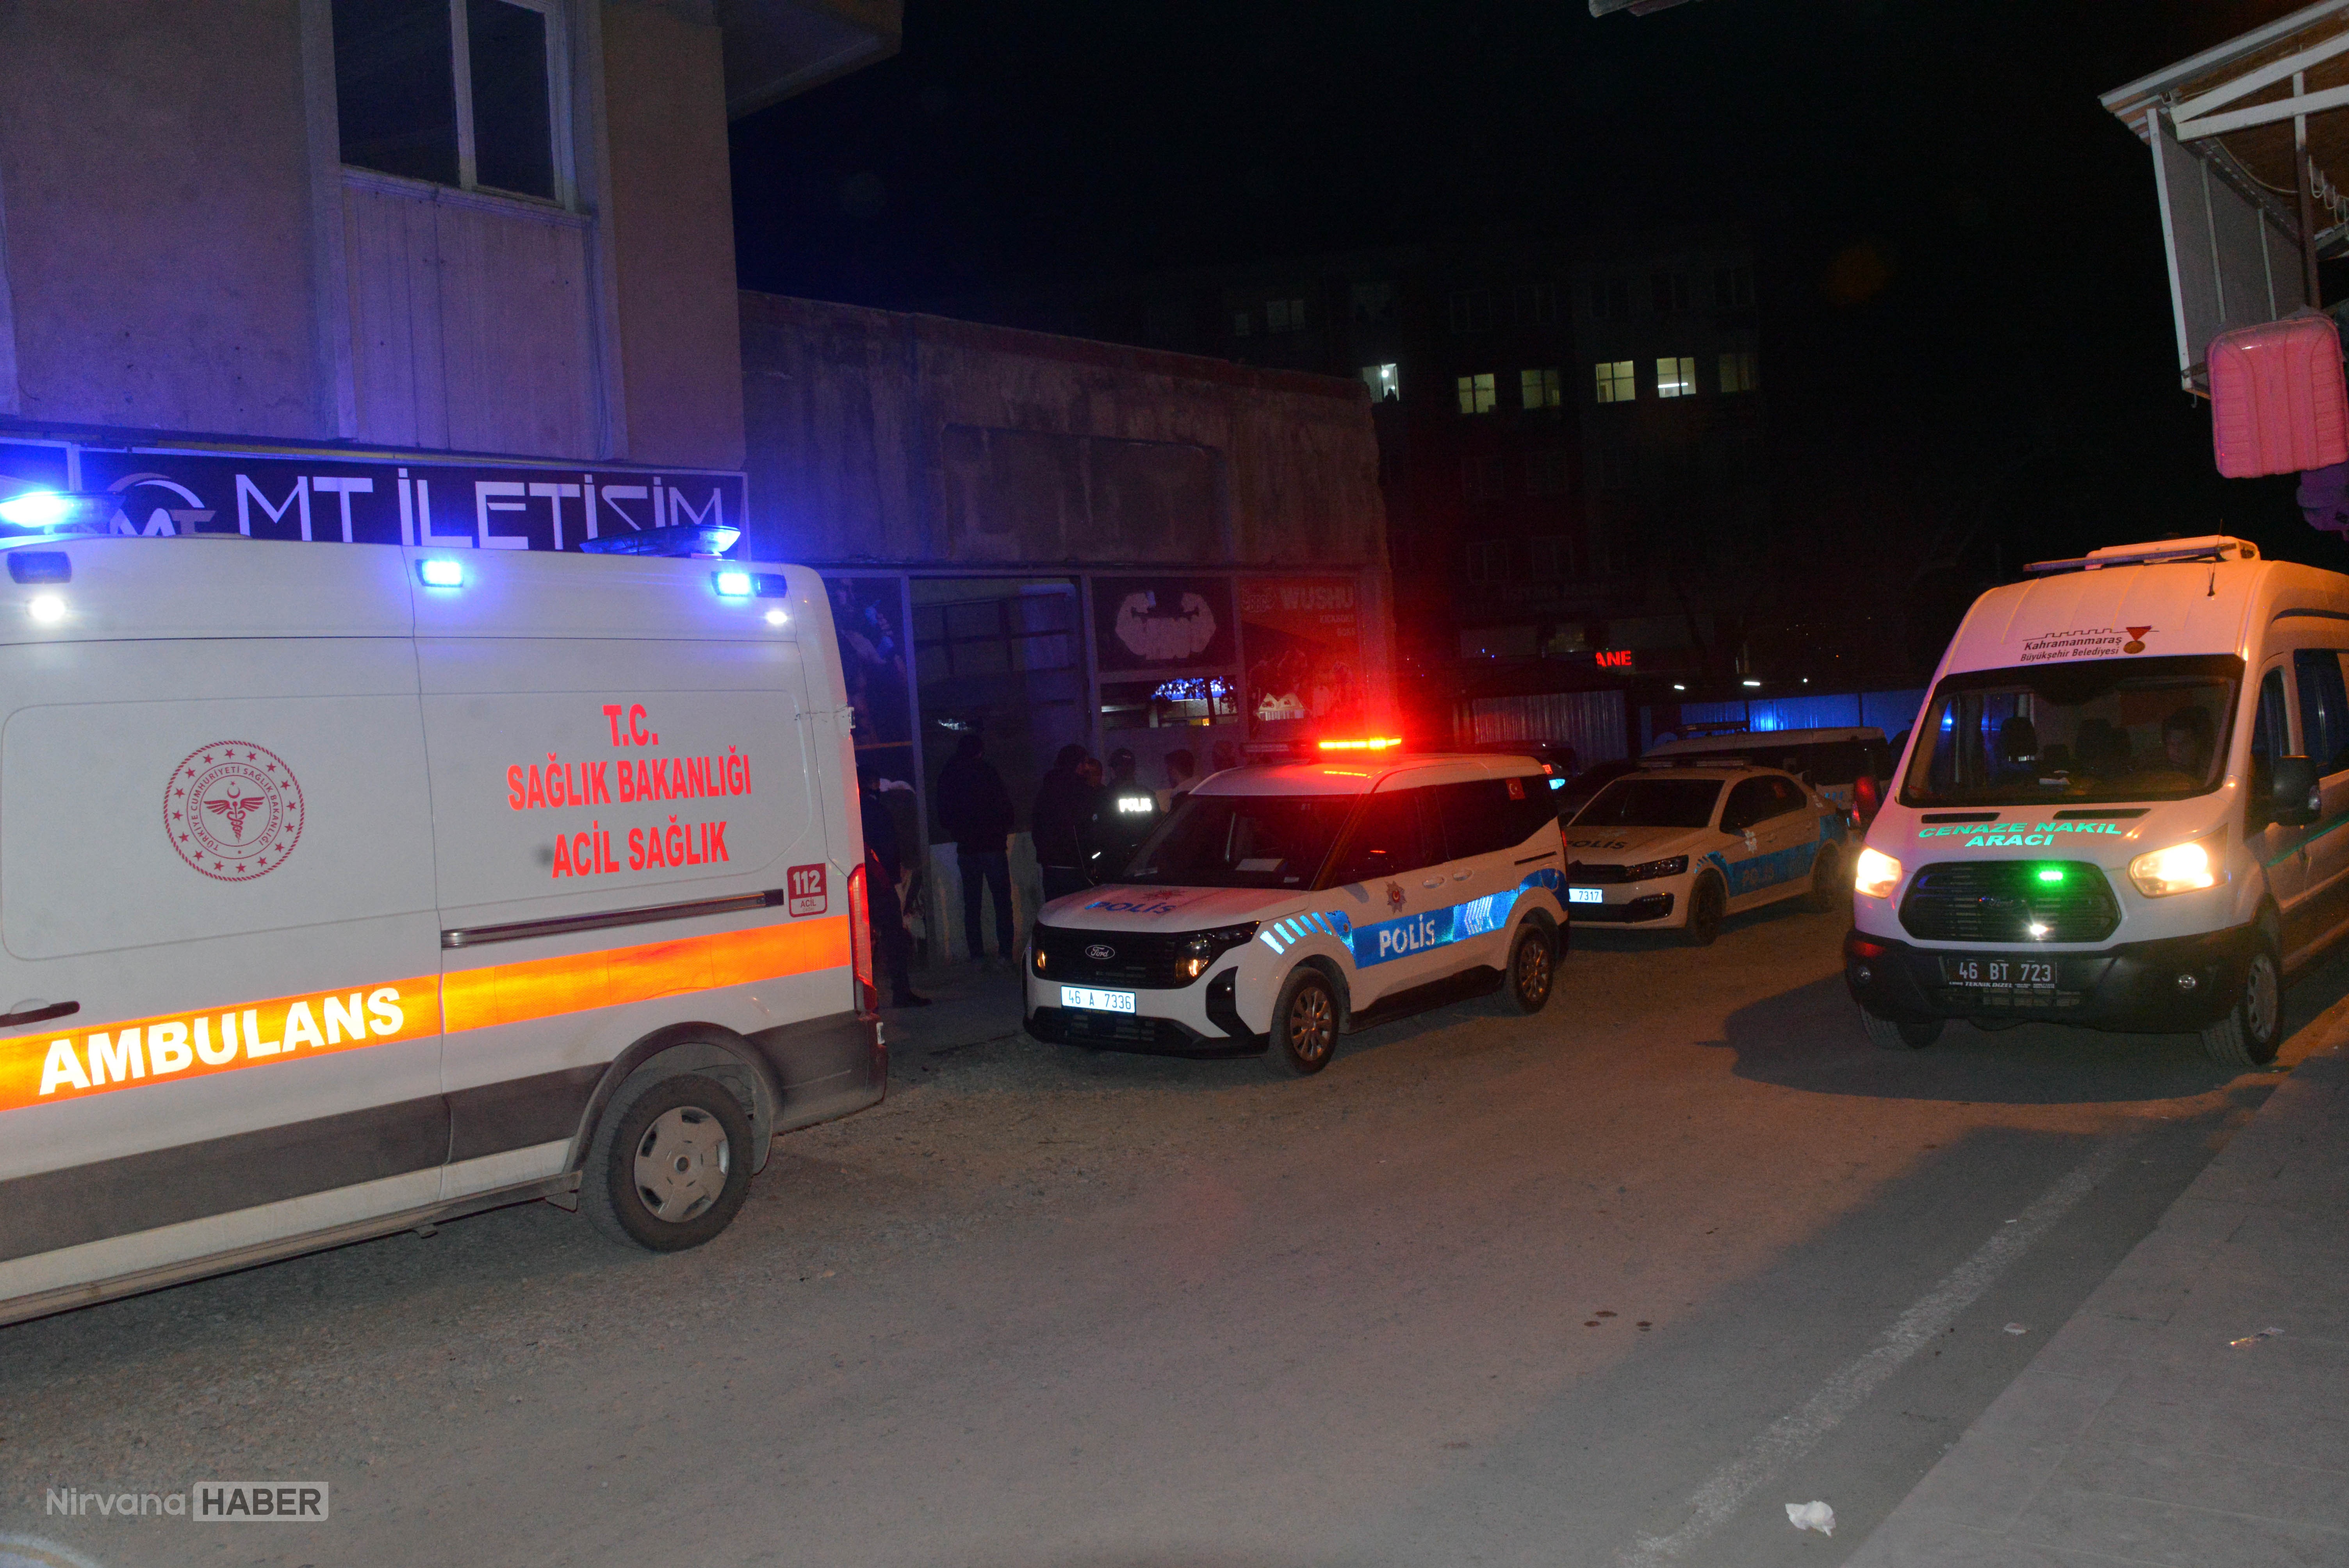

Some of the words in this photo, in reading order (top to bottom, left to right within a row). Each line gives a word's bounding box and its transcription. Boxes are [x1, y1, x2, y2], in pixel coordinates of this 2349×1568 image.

[235, 474, 372, 543] MT
[2020, 649, 2070, 662] Büyükşehir
[2072, 646, 2119, 657] Belediyesi
[2024, 636, 2123, 651] Kahramanmaraş
[602, 704, 659, 747] T.C.
[191, 765, 240, 811] CUMHURİYETİ
[243, 768, 274, 793] SAĞLIK
[507, 752, 611, 811] SAĞLIK
[617, 745, 752, 803] BAKANLIĞI
[258, 794, 280, 846] BAKANLIĞI
[1918, 823, 2028, 838] CENAZE
[191, 814, 219, 852] TÜRKİYE
[1965, 834, 2054, 847] ARACI
[552, 820, 620, 878] ACİL
[628, 814, 729, 871] SAĞLIK
[793, 870, 821, 895] 112
[800, 897, 816, 908] ACİL
[1084, 901, 1176, 914] POLİS
[1579, 891, 1599, 901] 7317
[1379, 914, 1435, 958] POLİS
[1091, 946, 1109, 957] Ford
[1959, 961, 1978, 979] 46
[1989, 962, 2009, 981] BT
[2020, 963, 2051, 982] 723
[1069, 990, 1081, 1004] 46
[1089, 992, 1094, 1006] A
[1104, 993, 1131, 1010] 7336
[39, 987, 404, 1096] AMBULANS
